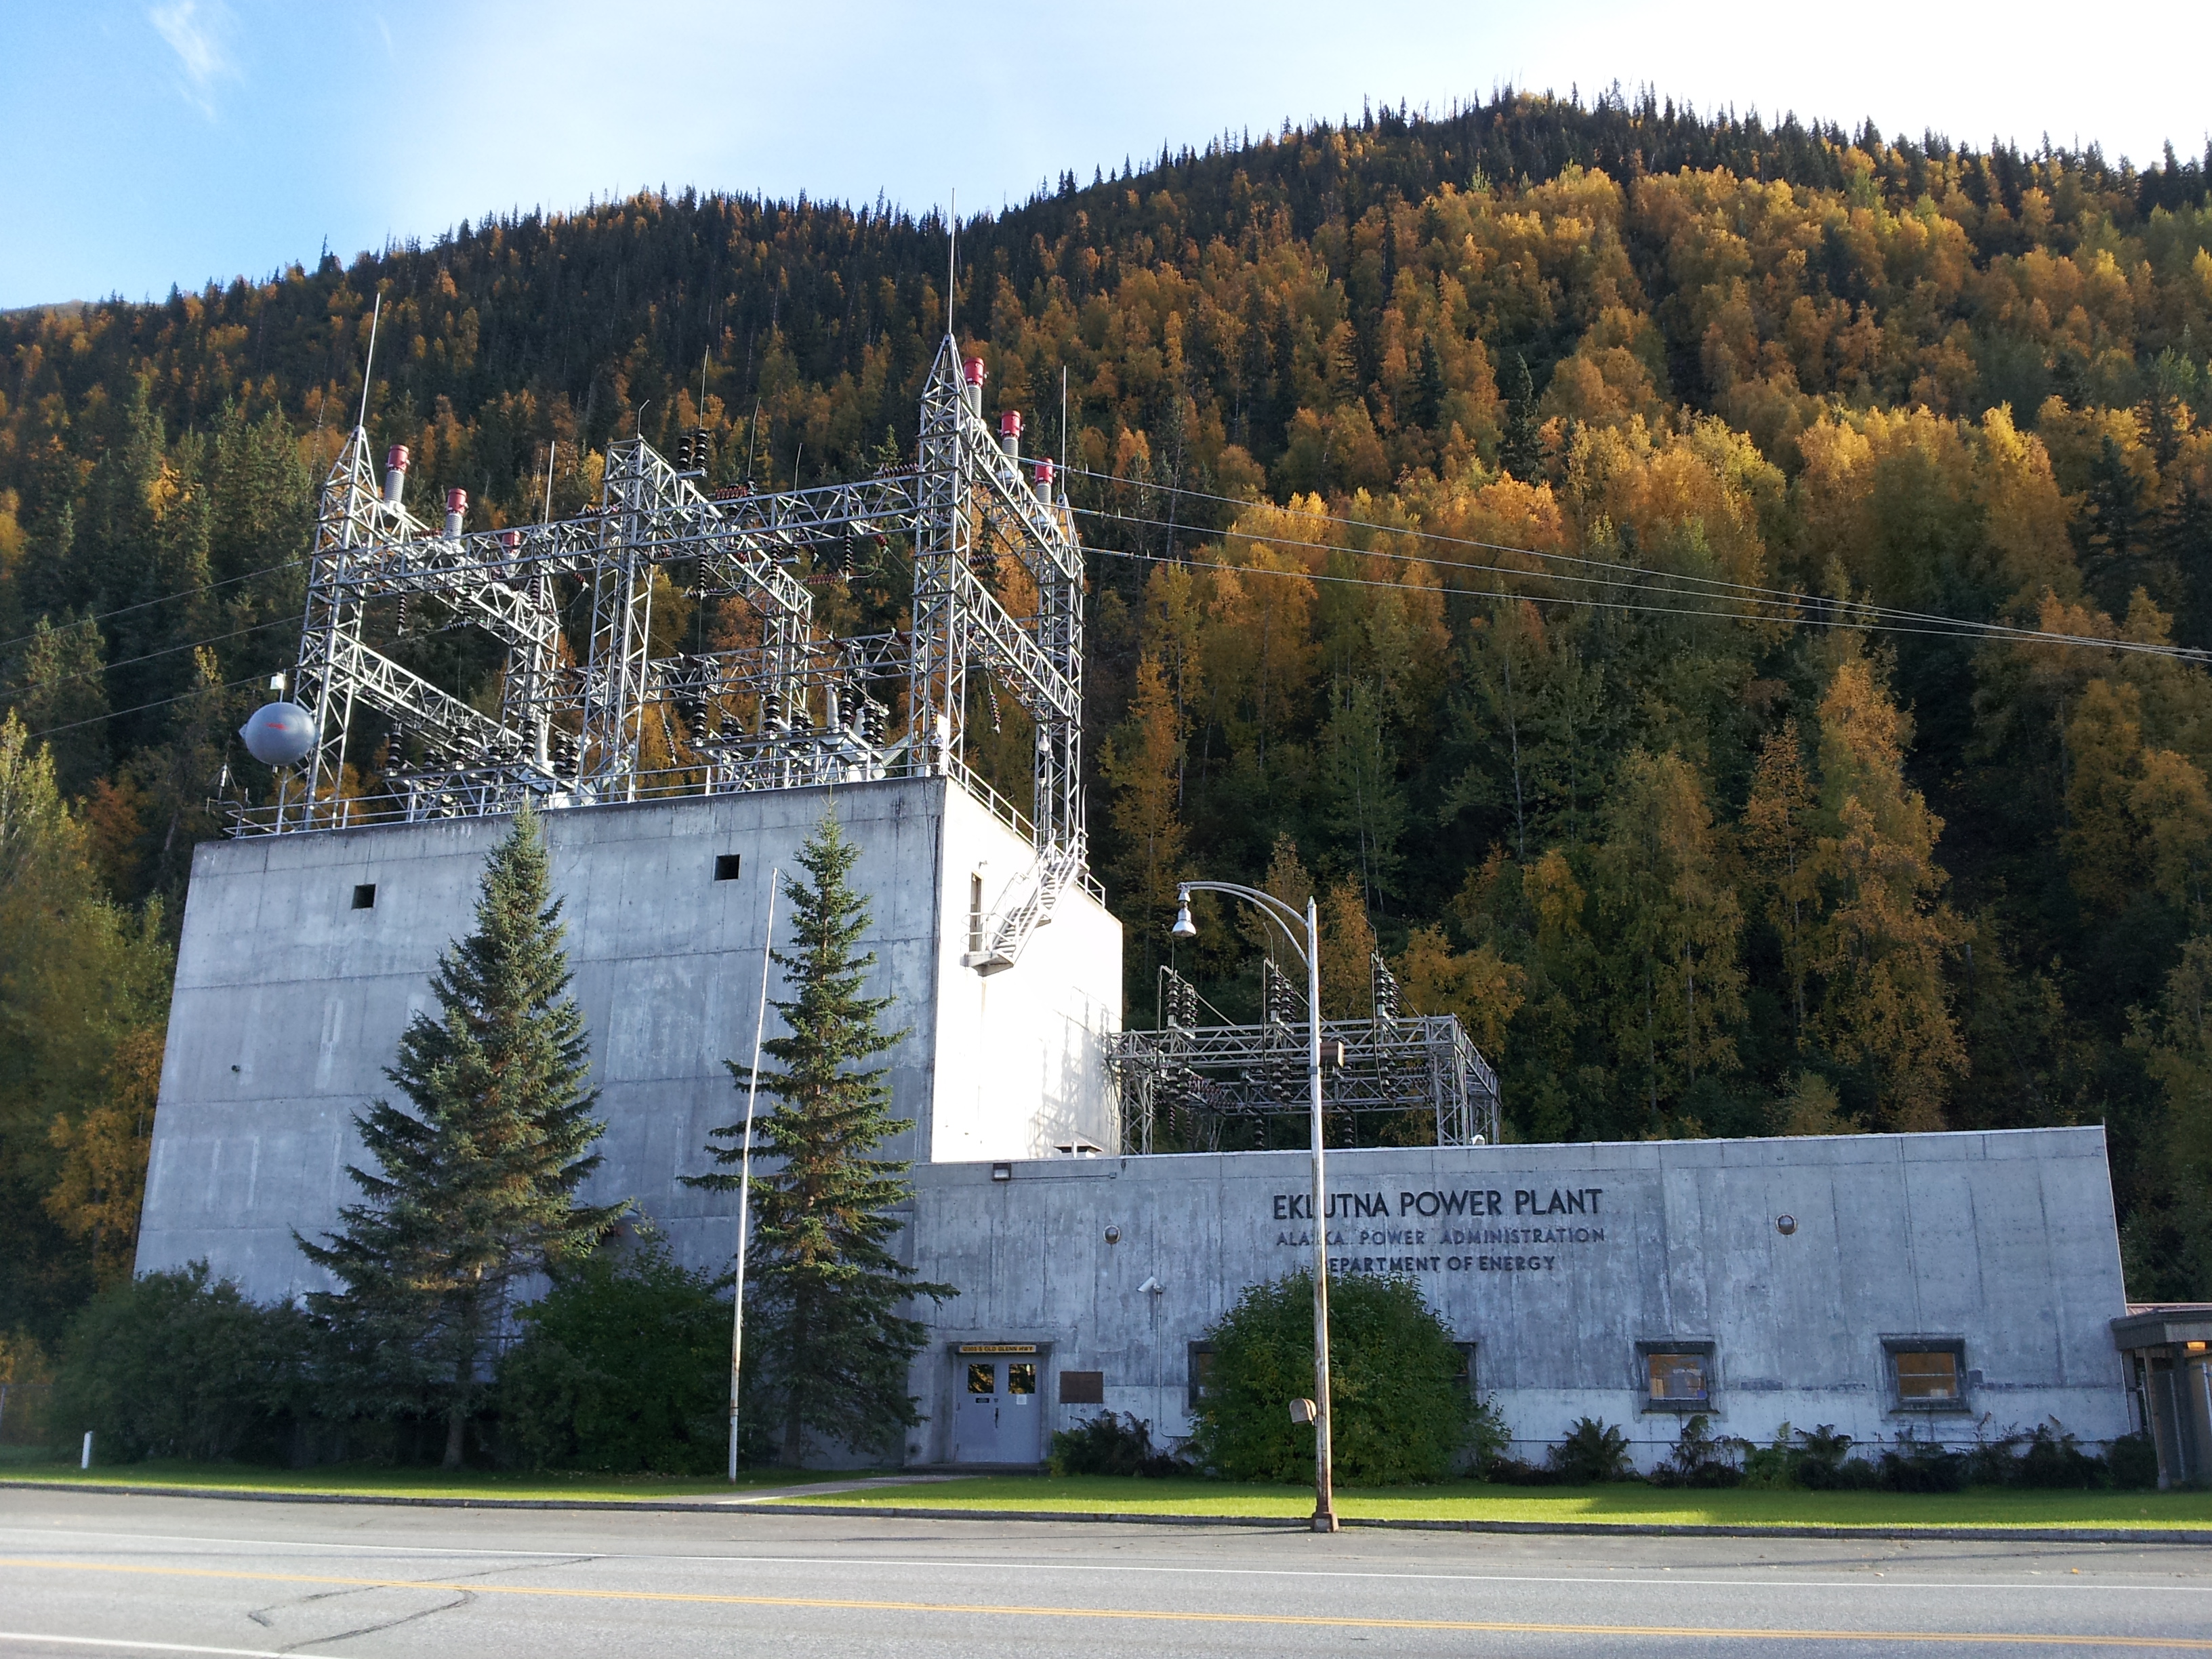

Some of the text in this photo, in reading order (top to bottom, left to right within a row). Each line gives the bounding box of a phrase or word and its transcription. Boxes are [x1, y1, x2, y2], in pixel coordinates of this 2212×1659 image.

[1273, 1189, 1603, 1219] EKLUTNA POWER PLANT
[1276, 1228, 1604, 1246] ALAKA POWER ADMINISTRATION
[1326, 1256, 1555, 1272] EPARTMENT OF ENERGY
